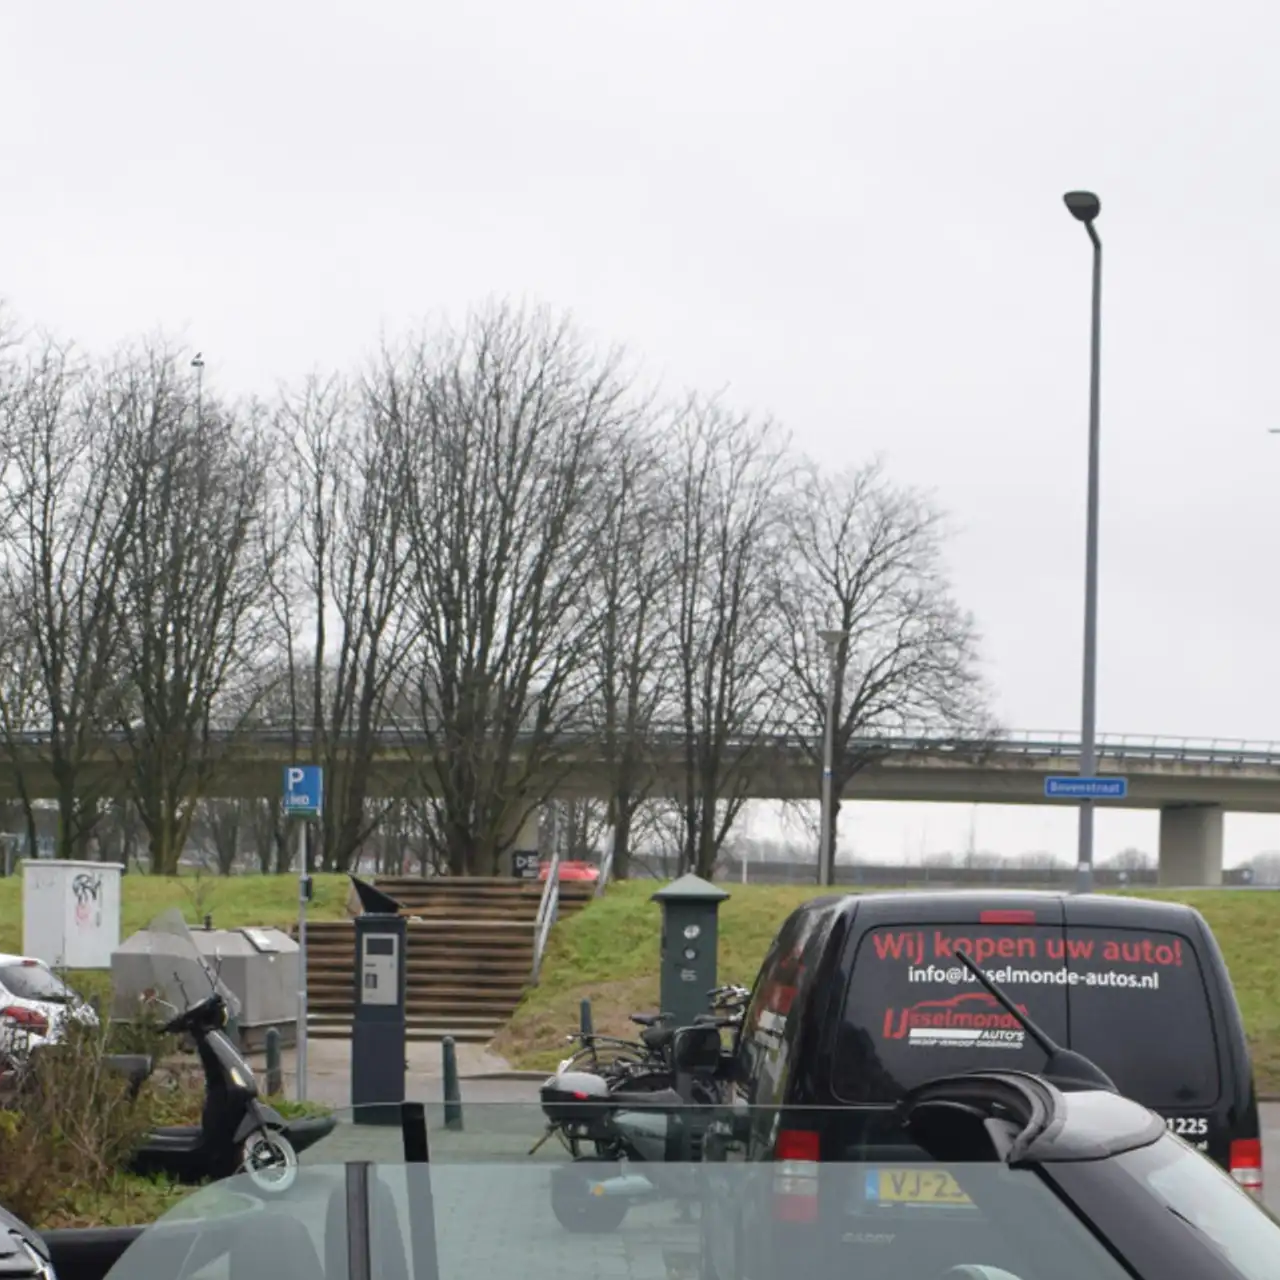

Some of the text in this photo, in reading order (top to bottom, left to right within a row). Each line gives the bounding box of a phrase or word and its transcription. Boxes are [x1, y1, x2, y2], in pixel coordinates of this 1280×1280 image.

[288, 767, 305, 791] P
[872, 931, 1183, 967] Wij kopen uw auto!
[883, 1008, 1027, 1039] IJsselmond
